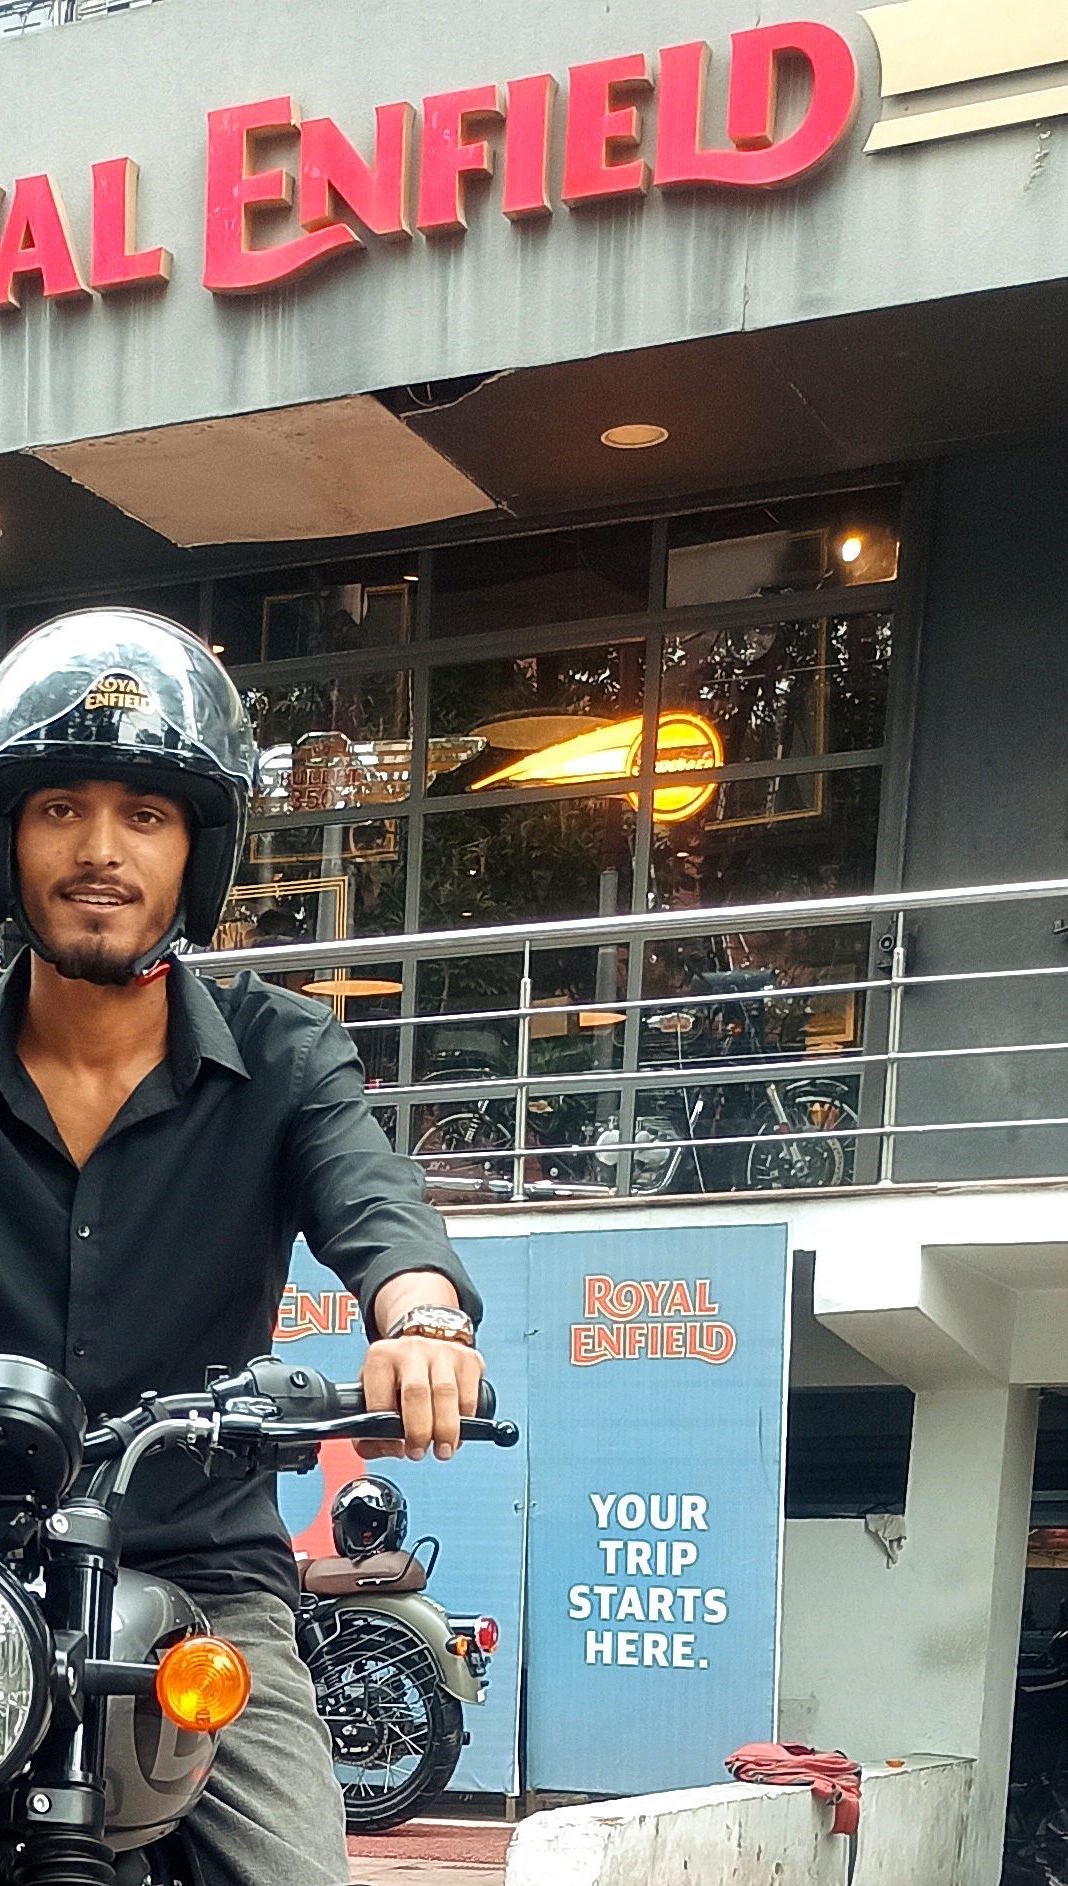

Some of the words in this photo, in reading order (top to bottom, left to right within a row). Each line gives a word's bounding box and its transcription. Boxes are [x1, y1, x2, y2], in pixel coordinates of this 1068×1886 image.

[203, 21, 860, 295] ENFIELD
[585, 1275, 719, 1321] ROYAL
[570, 1322, 737, 1366] ENFIELD
[589, 1493, 709, 1530] YOUR
[598, 1540, 698, 1576] TRIP
[568, 1584, 728, 1624] STARTS
[585, 1630, 709, 1669] HERE.
